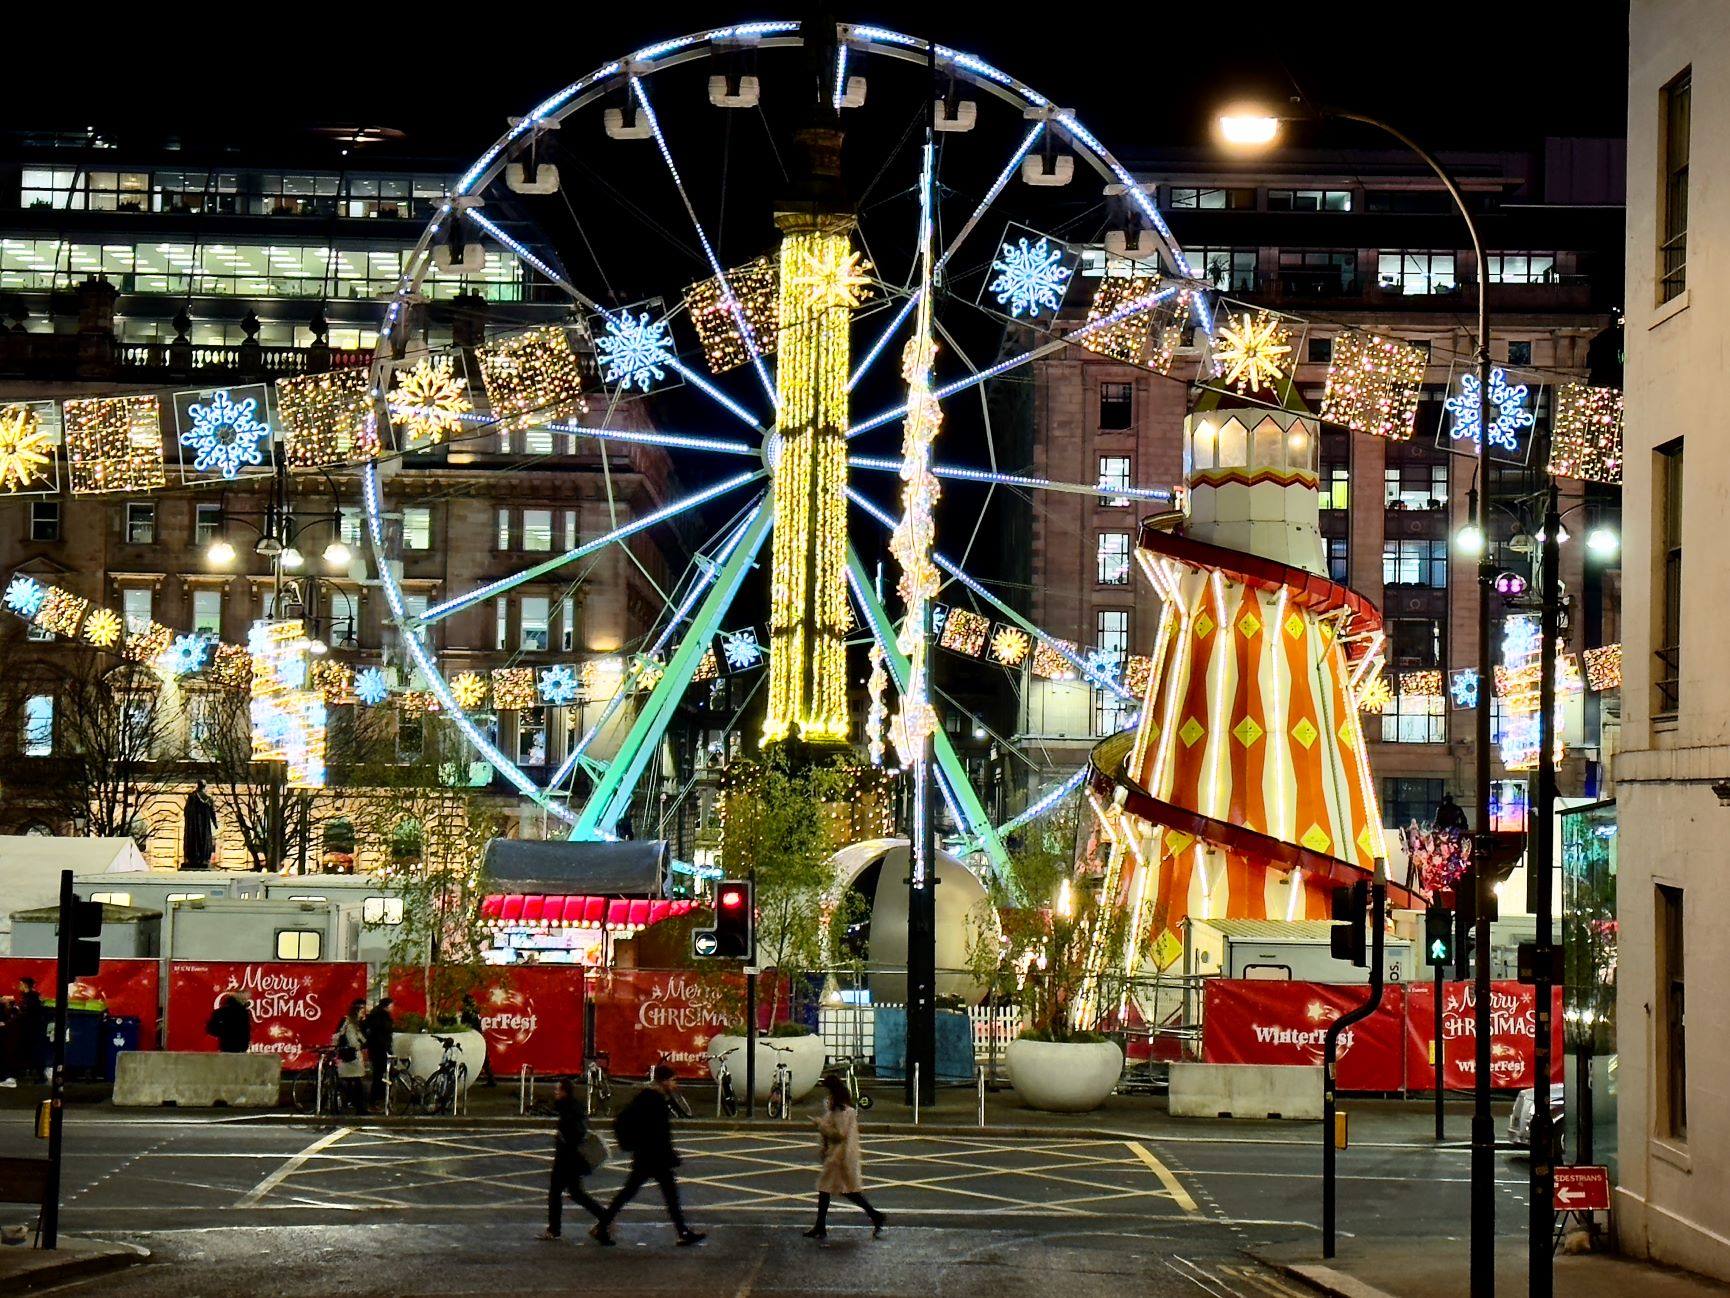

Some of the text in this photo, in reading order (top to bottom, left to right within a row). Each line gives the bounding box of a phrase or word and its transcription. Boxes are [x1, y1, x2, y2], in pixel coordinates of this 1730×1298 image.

[240, 966, 300, 996] Merry
[214, 991, 321, 1023] CRISTMAS
[1459, 986, 1519, 1014] Mrry
[479, 1013, 537, 1031] erFest
[1442, 1010, 1535, 1039] CHRTMAS
[1253, 1027, 1354, 1046] WinterFst
[1455, 1060, 1525, 1074] WierFest
